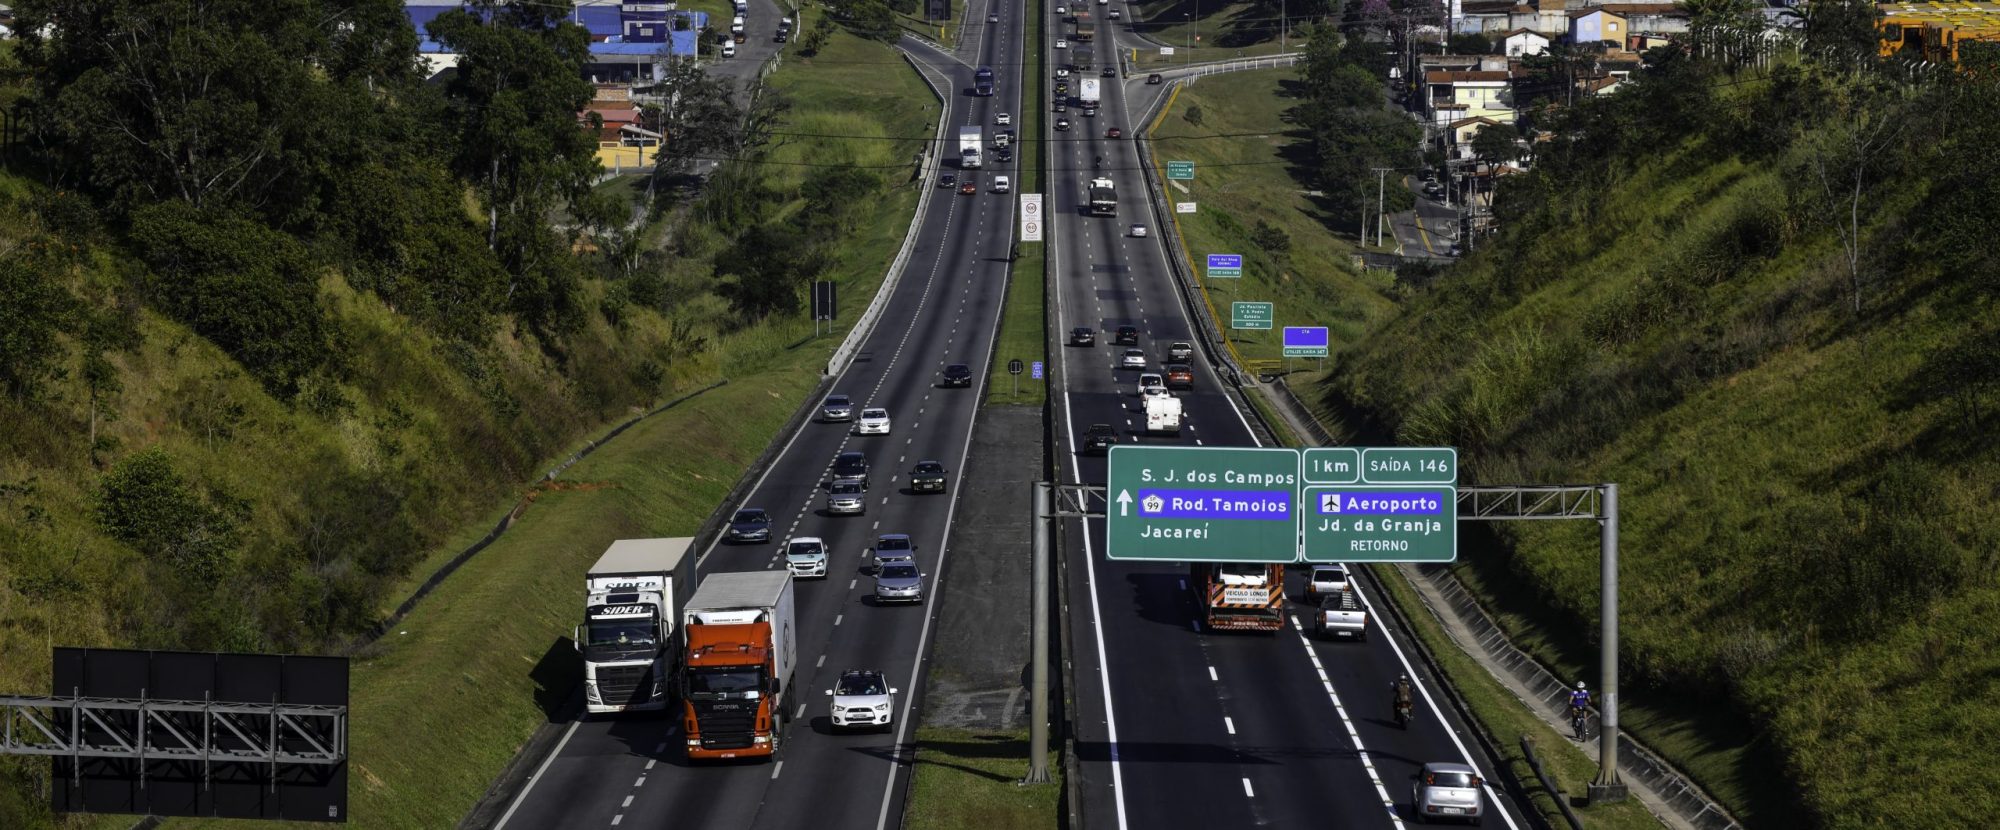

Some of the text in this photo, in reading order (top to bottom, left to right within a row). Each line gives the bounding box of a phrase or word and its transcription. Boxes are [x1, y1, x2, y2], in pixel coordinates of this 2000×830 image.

[1314, 460, 1349, 472] 1 km
[1370, 456, 1448, 472] SAÍDA 146
[1142, 468, 1294, 487] S. J. dos Campos
[1147, 502, 1159, 510] 99
[1172, 498, 1287, 512] Rod. Tamoios
[1346, 497, 1437, 512] Aeroporto
[1140, 522, 1209, 539] Jacareí
[1318, 519, 1442, 536] Jd. da Granja
[1350, 540, 1408, 551] RETORNO
[600, 606, 644, 615] SIDER
